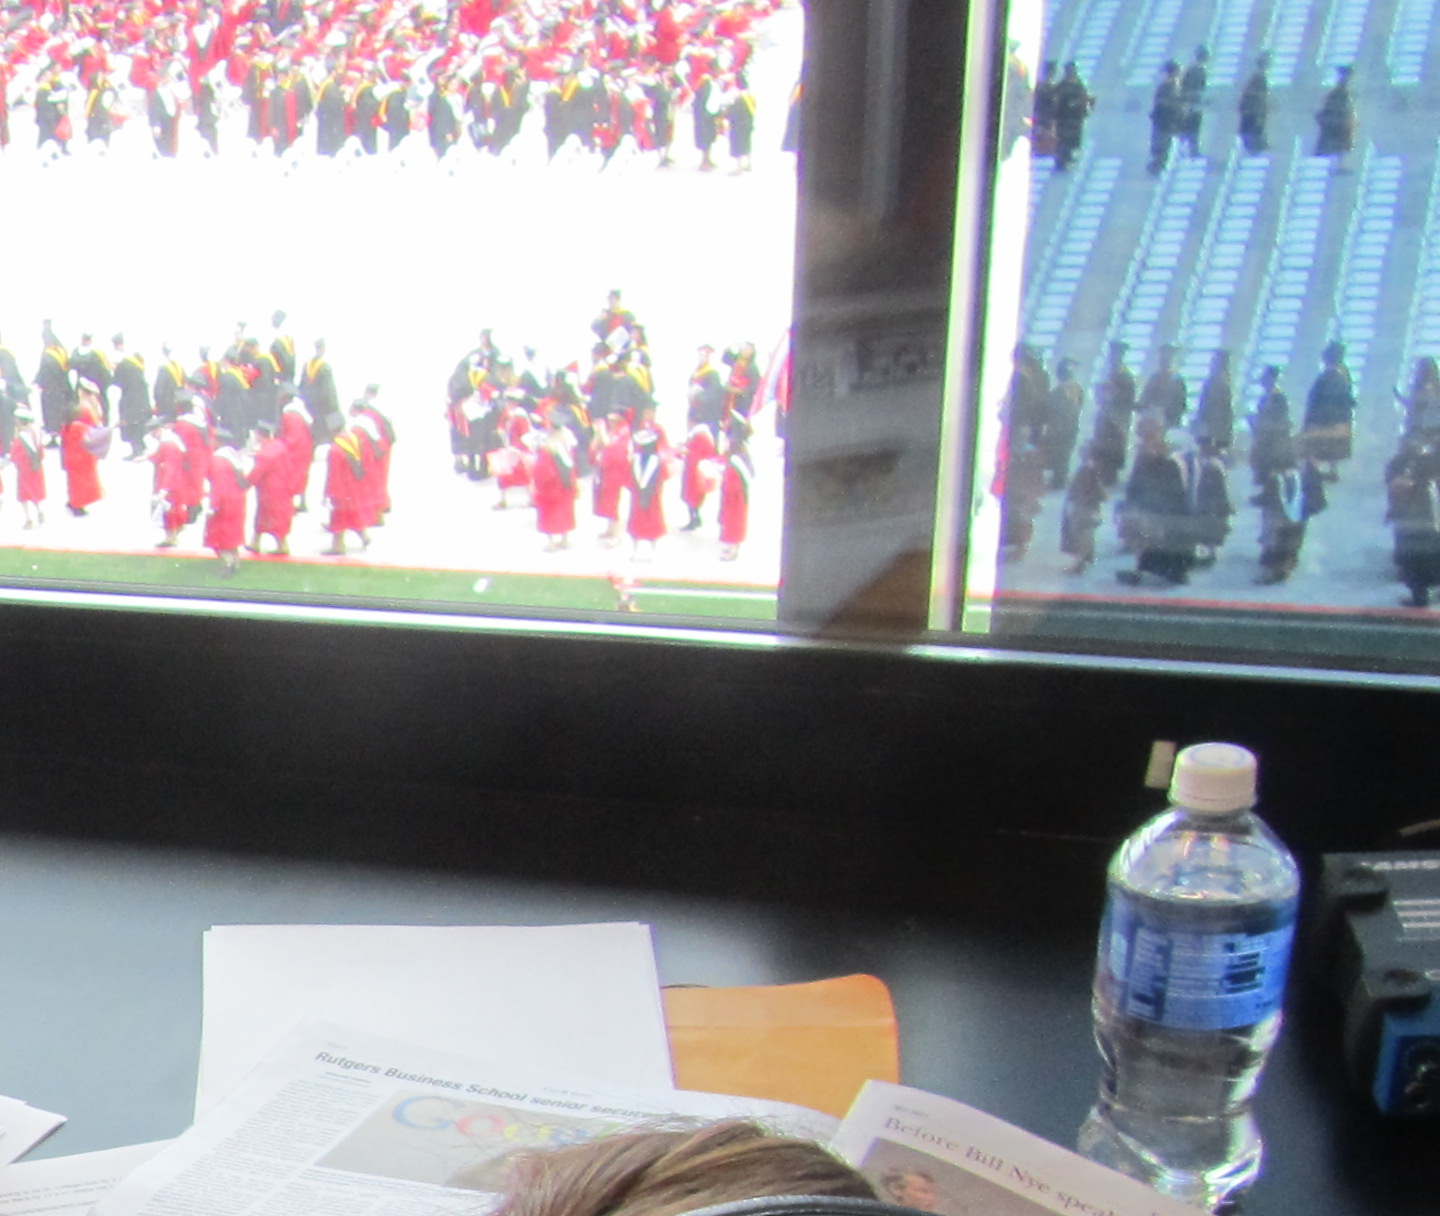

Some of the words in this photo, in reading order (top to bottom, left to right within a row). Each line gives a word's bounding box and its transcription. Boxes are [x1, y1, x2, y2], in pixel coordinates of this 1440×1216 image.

[315, 1050, 382, 1076] Rutgers
[384, 1066, 463, 1093] Business
[465, 1083, 527, 1103] School
[529, 1095, 589, 1112] senior
[885, 1116, 961, 1153] Before
[964, 1145, 1005, 1172] Bill
[1009, 1165, 1051, 1194] Nye
